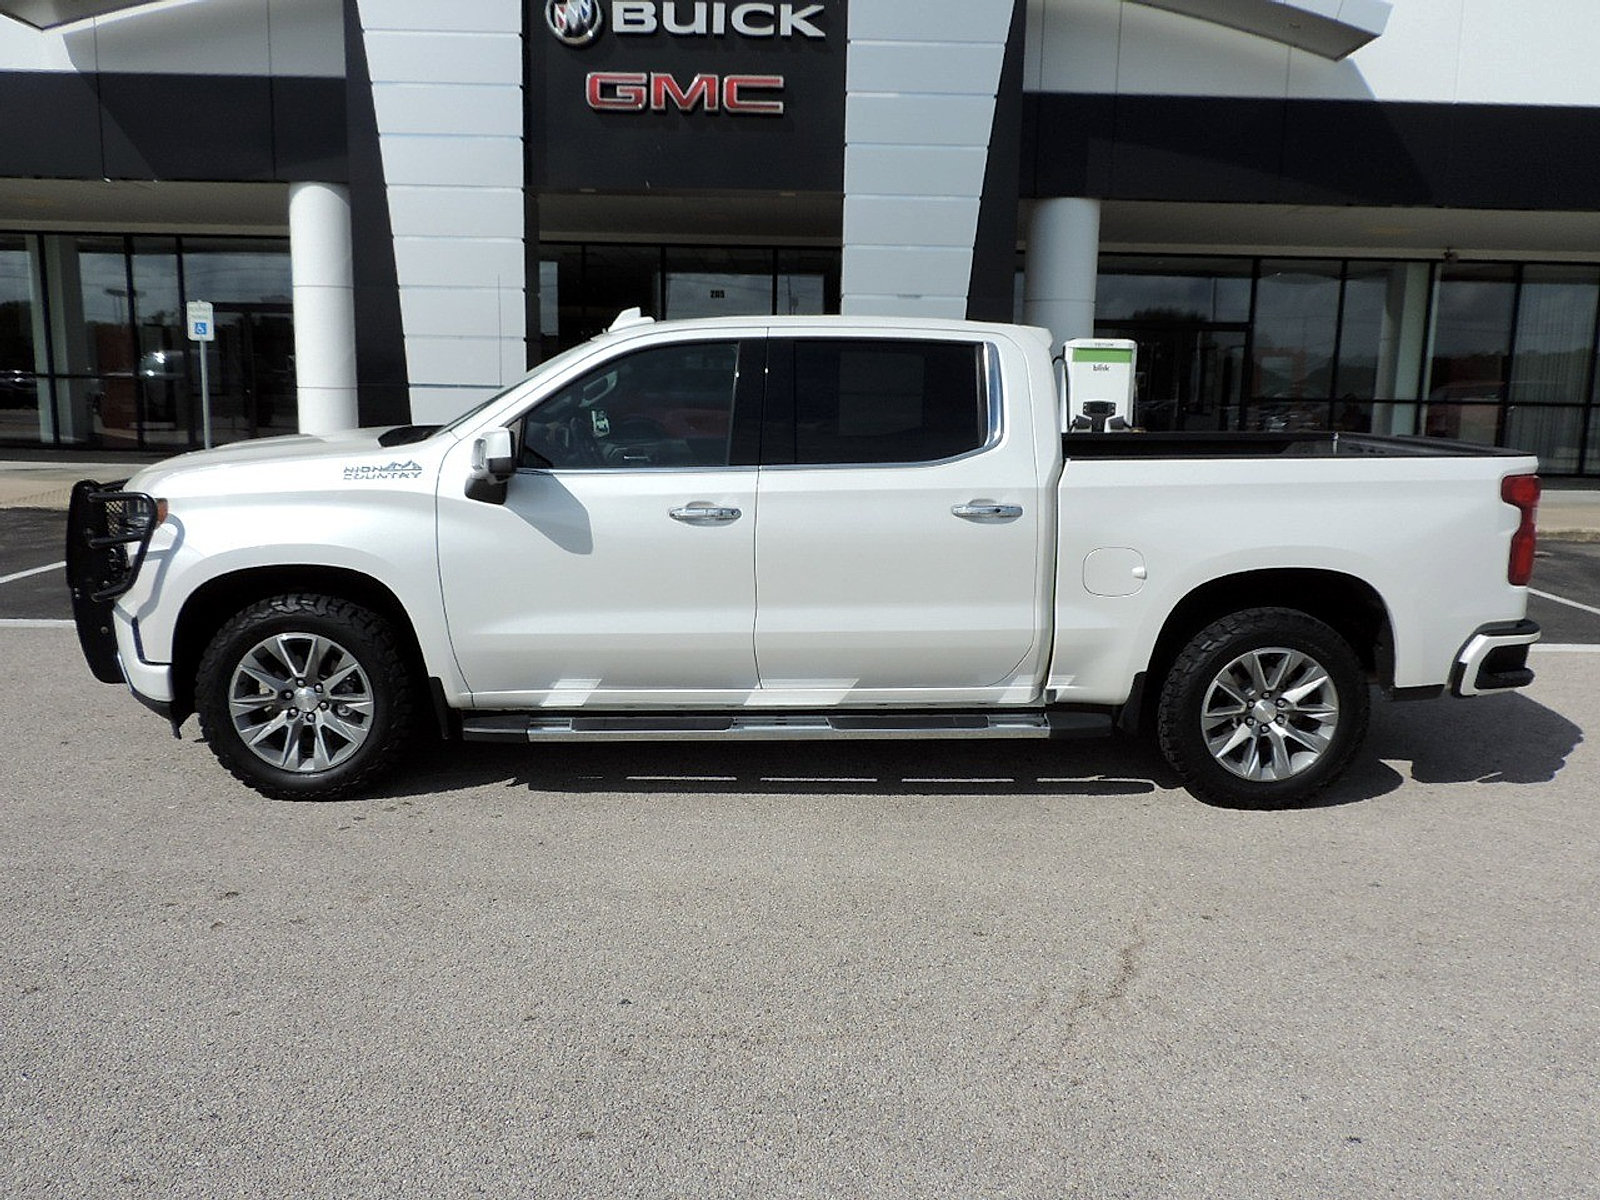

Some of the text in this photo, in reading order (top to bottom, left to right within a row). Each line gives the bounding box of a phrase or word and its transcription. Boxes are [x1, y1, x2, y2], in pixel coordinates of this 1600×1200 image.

[612, 2, 826, 37] BUICK
[585, 71, 784, 114] GMC
[343, 471, 422, 480] COUNTRY
